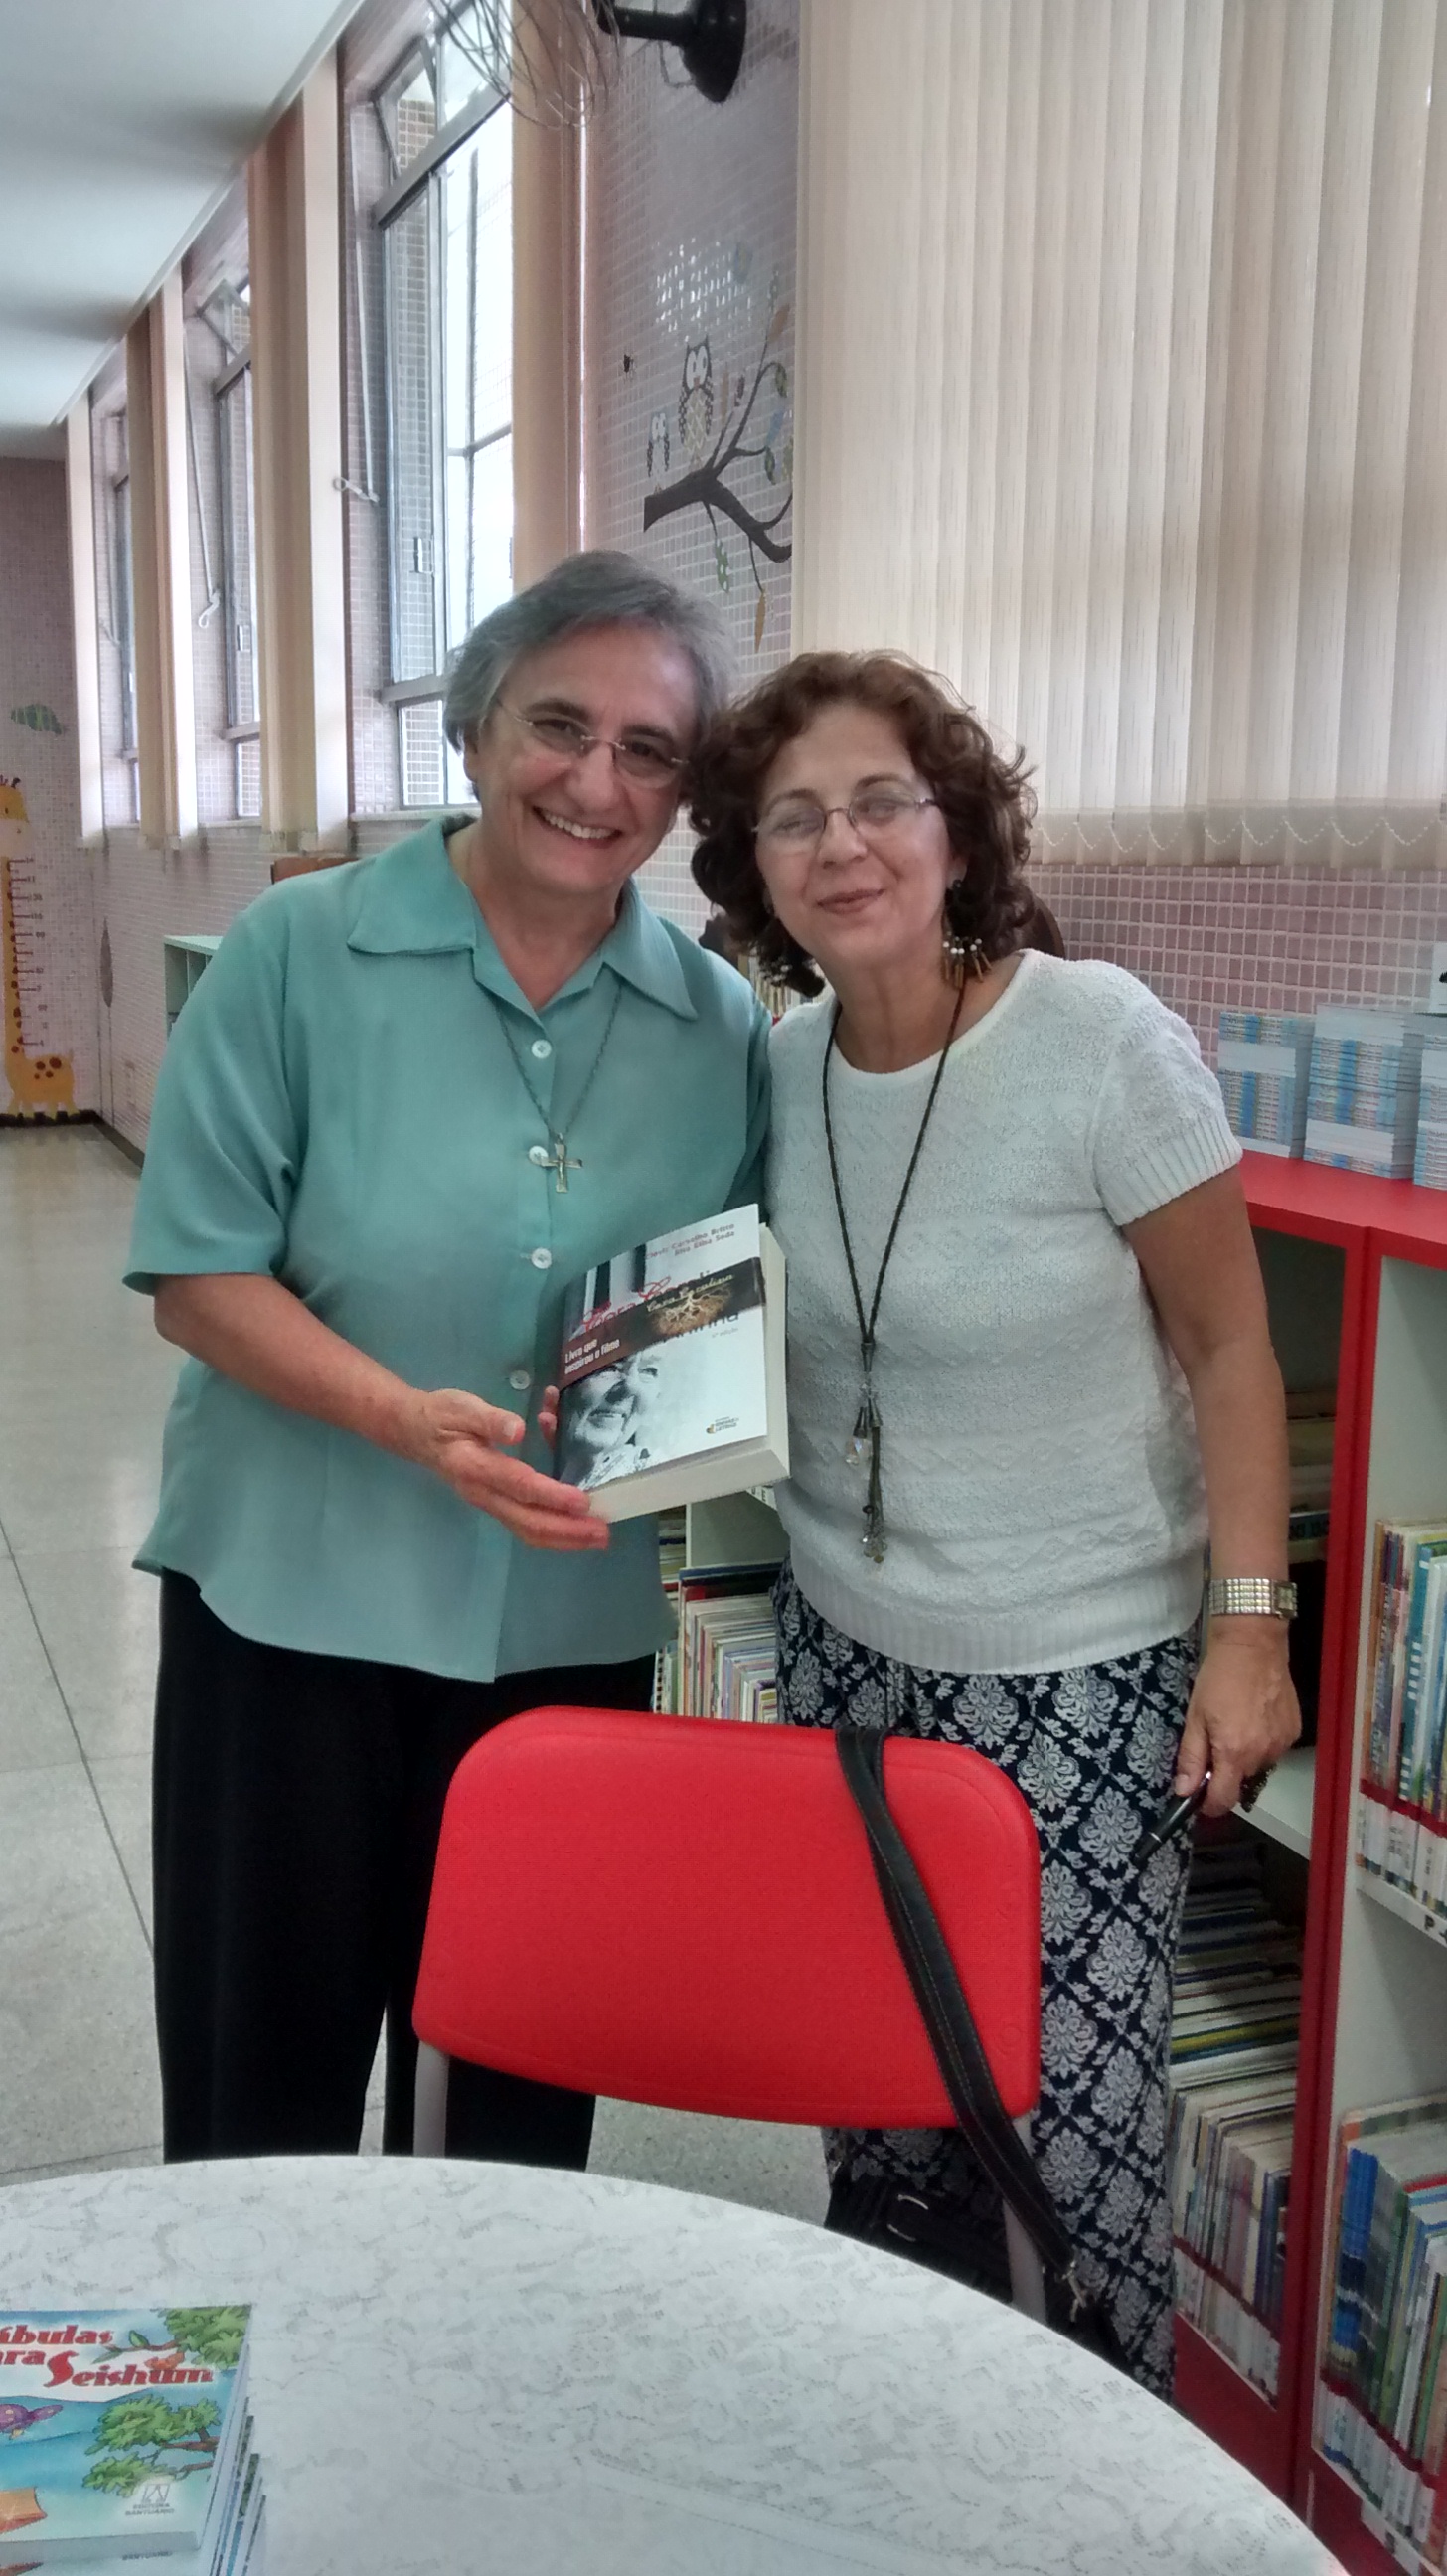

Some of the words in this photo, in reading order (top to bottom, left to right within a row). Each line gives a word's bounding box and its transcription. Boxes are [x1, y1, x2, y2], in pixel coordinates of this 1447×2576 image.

[564, 1347, 583, 1364] Livro
[583, 1338, 598, 1353] que
[600, 1339, 620, 1356] filme
[0, 2350, 46, 2365] ra
